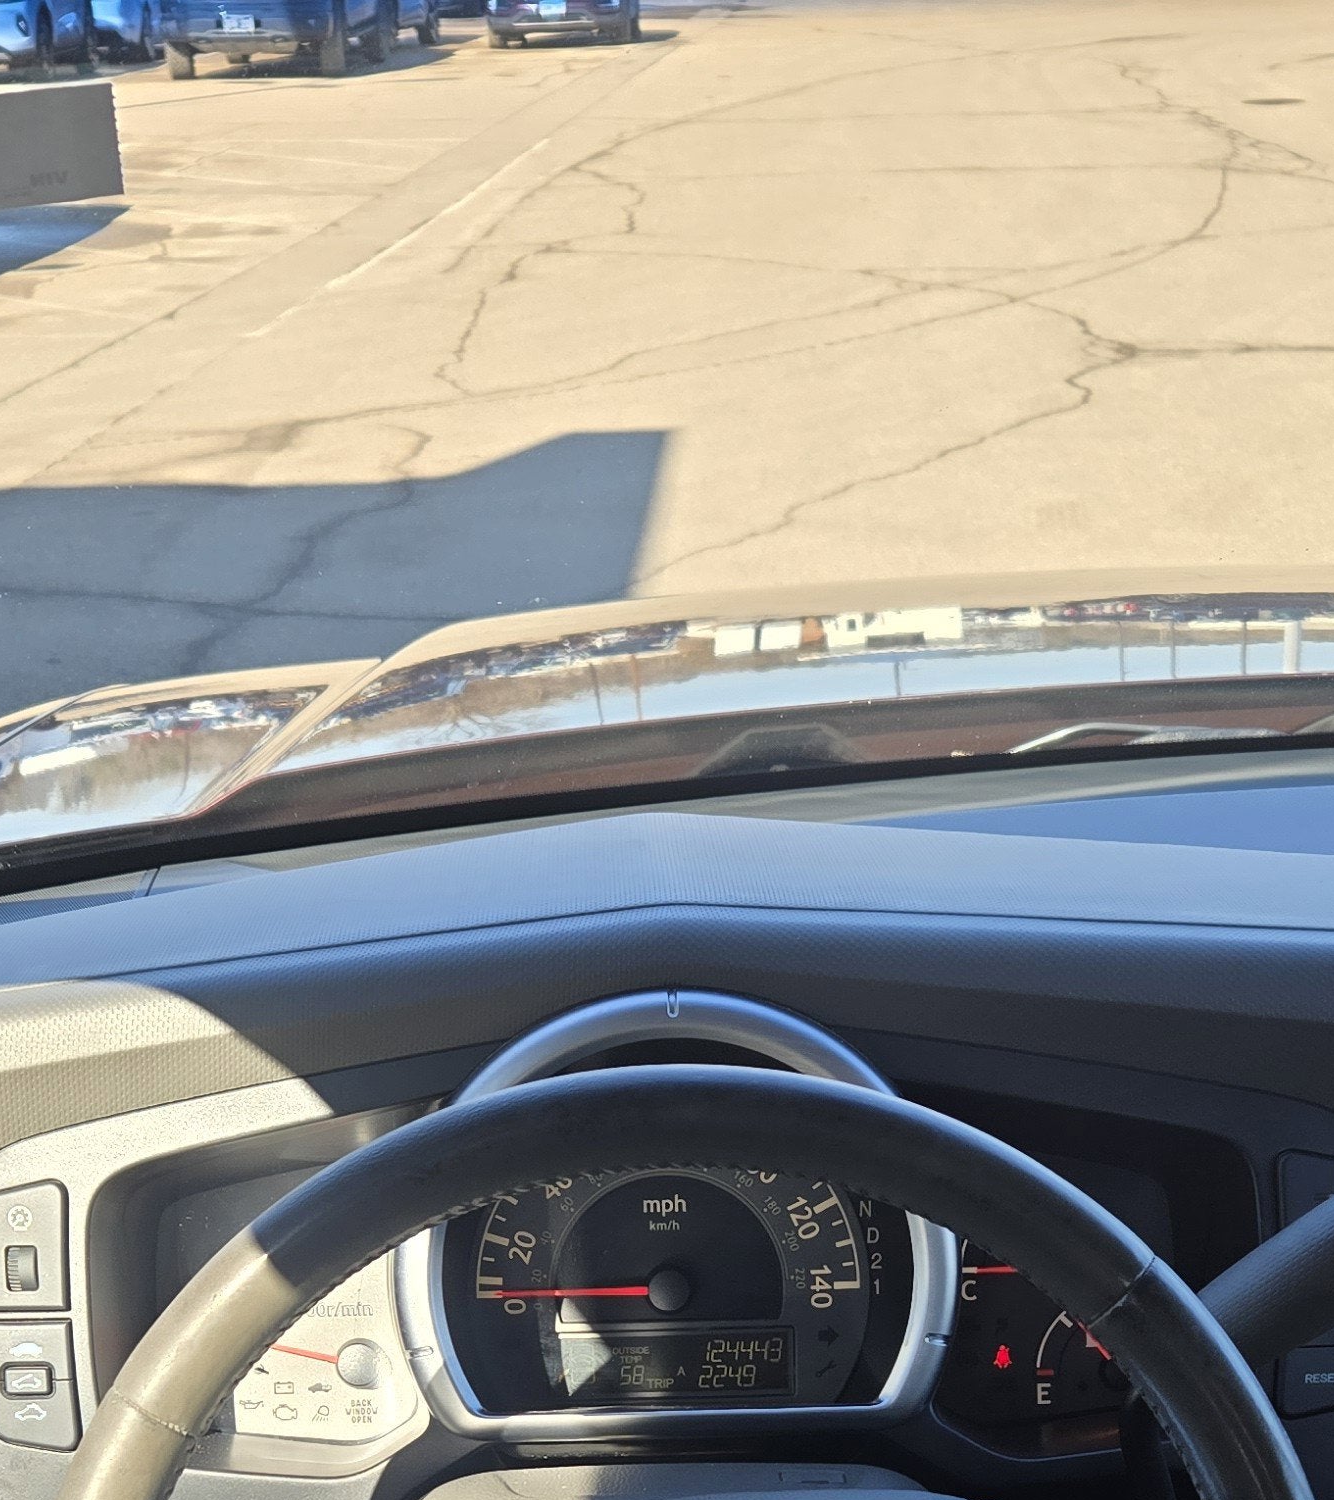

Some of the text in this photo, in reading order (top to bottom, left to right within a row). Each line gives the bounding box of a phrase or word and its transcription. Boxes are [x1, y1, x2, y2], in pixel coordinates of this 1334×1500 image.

[734, 1170, 754, 1188] 160
[642, 1194, 687, 1217] mph
[764, 1195, 782, 1216] 180
[859, 1200, 872, 1217] N
[649, 1220, 681, 1231] km/h
[786, 1196, 820, 1240] 120
[784, 1231, 800, 1252] 200
[867, 1227, 880, 1244] D
[508, 1231, 536, 1265] 20
[871, 1253, 883, 1270] 2
[794, 1267, 806, 1289] 220
[810, 1265, 833, 1309] 140
[961, 1279, 978, 1301] C
[503, 1298, 527, 1315] 0
[706, 1337, 784, 1363] 124443
[620, 1365, 645, 1386] 58
[646, 1366, 686, 1389] TRIP A
[1036, 1382, 1052, 1405] E
[345, 1407, 378, 1415] WINDOW
